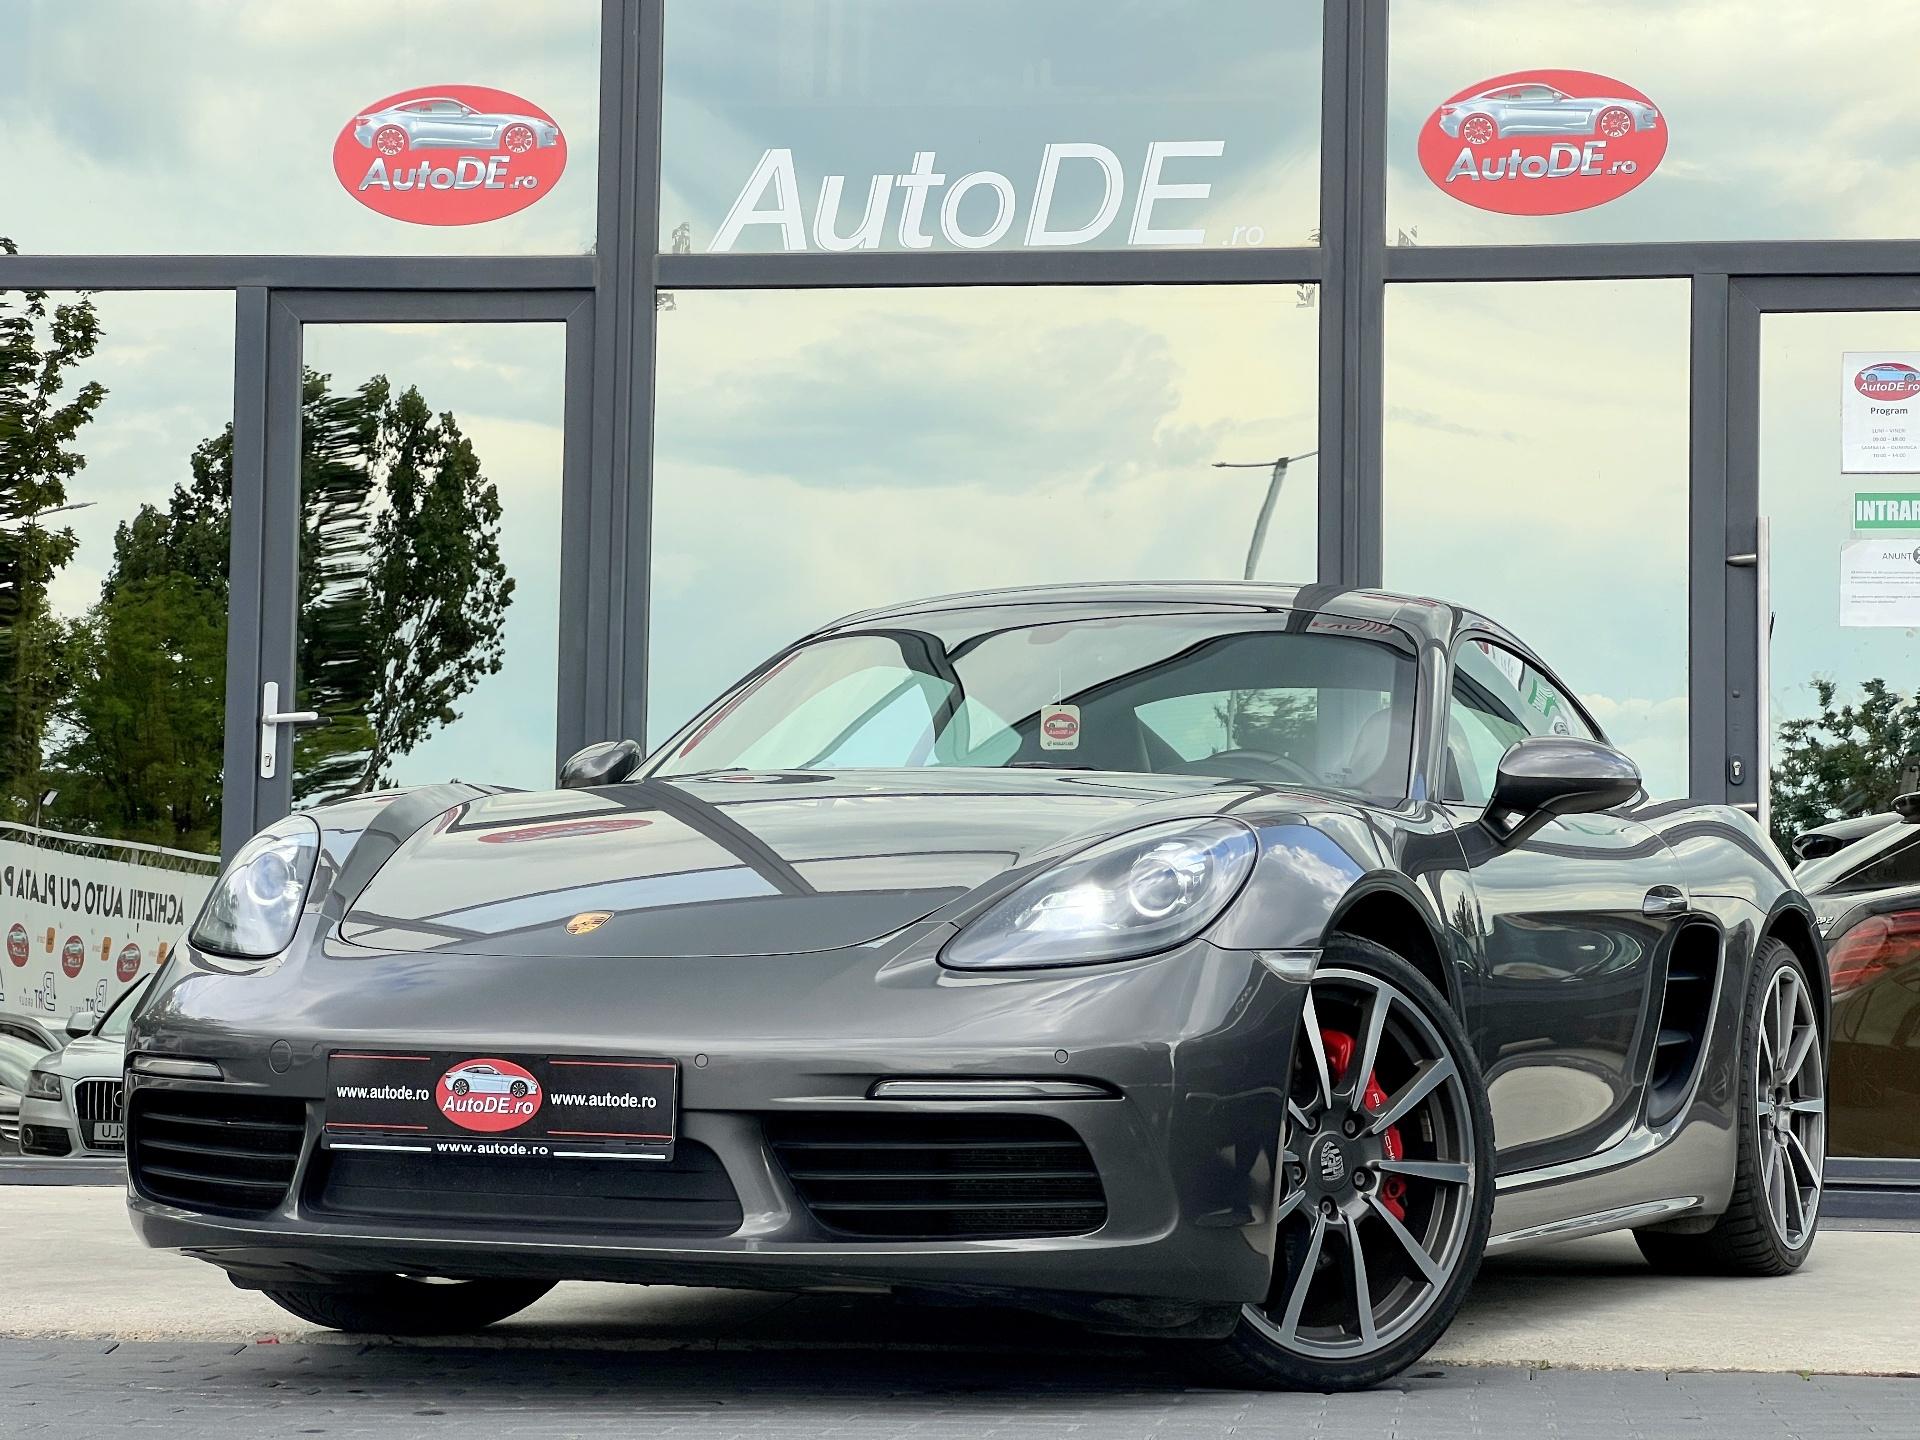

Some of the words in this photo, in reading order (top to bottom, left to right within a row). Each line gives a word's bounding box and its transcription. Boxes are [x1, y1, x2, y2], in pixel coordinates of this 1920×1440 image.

[1859, 381, 1920, 392] AutoDE.ro
[1870, 407, 1908, 416] Program
[336, 1083, 430, 1101] www.autode.ro
[550, 1091, 657, 1109] www.autode.ro
[442, 1096, 534, 1116] AutoDE.ro
[436, 1141, 549, 1156] www.autode.ro
